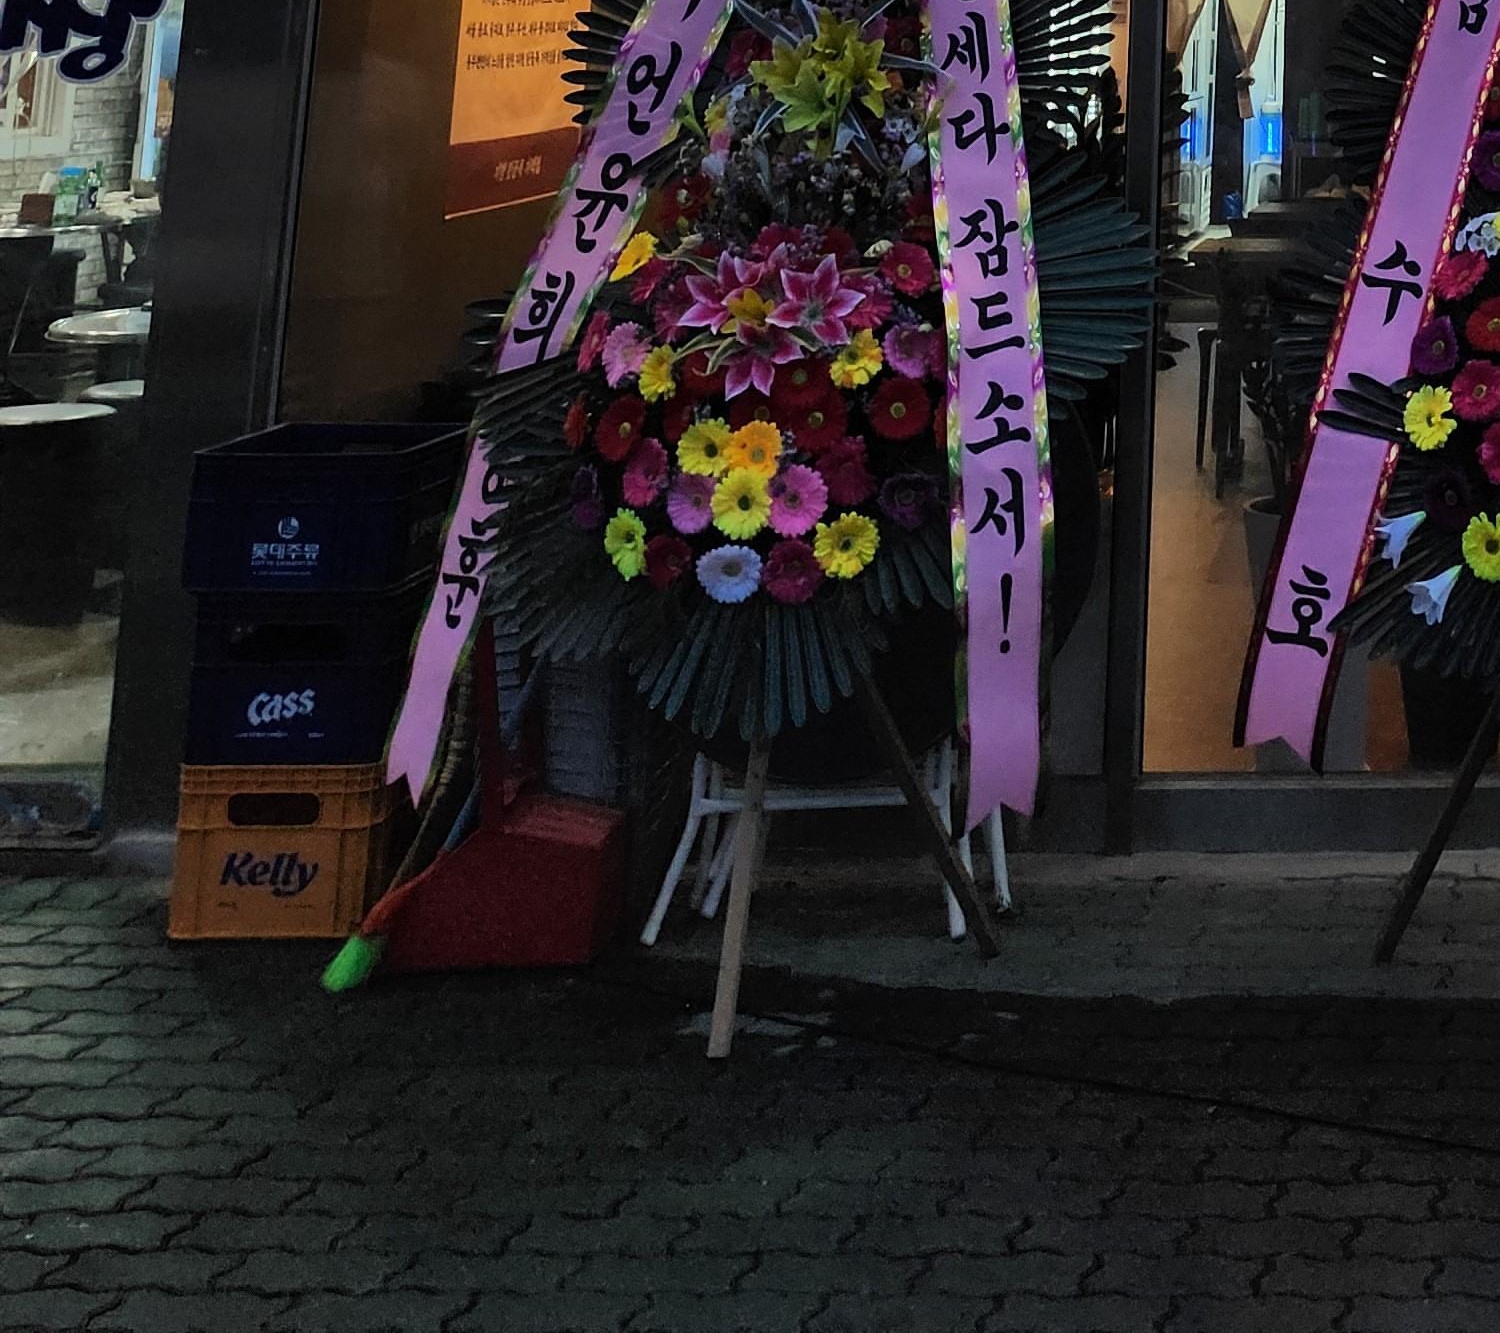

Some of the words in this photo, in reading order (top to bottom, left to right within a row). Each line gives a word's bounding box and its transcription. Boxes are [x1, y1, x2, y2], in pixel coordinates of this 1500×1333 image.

[953, 196, 1033, 654] 잠드소서!
[251, 542, 321, 561] 롯데주류
[246, 687, 317, 727] Cass
[219, 851, 320, 898] Kelly
